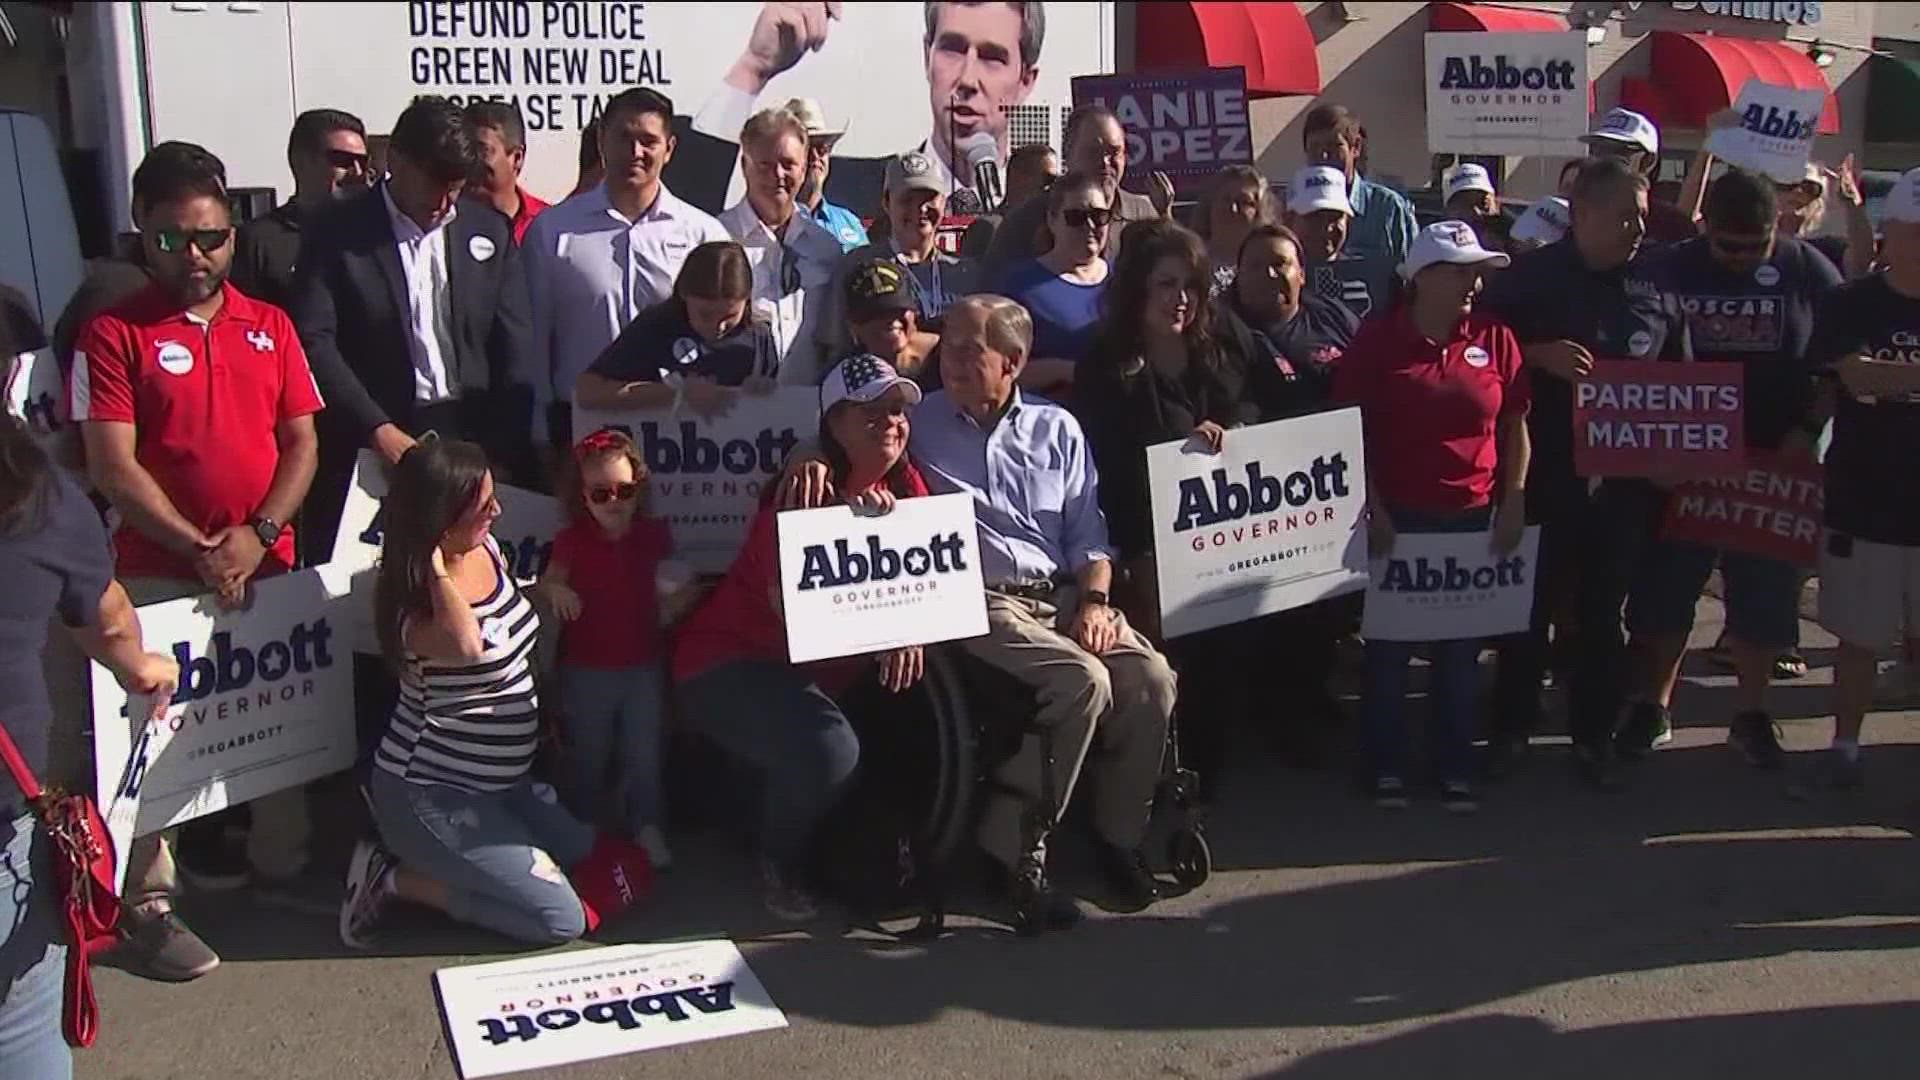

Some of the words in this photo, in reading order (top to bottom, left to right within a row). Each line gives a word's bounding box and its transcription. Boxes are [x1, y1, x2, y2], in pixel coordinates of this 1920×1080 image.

[409, 2, 531, 37] DEFUND
[542, 2, 645, 40] POLICE
[411, 47, 513, 85] GREEN
[524, 47, 589, 85] NEW
[600, 48, 672, 85] DEAL
[1440, 54, 1576, 90] Abbott
[1091, 89, 1247, 129] ANIE
[1451, 94, 1562, 105] GOVERNOR
[1125, 126, 1251, 167] OPEZ
[1577, 382, 1739, 411] PARENTS
[603, 421, 798, 475] bbott
[1587, 421, 1729, 450] MATTER
[660, 479, 759, 498] VERNO
[1172, 452, 1350, 533] Abbott
[1192, 507, 1336, 552] GOVERNOR
[797, 530, 968, 591] Abbott
[1378, 556, 1526, 594] Abbott
[833, 580, 937, 605] GOVERNOR
[169, 679, 315, 733] OVERNOR
[500, 973, 705, 1012] GOVERNOR
[478, 981, 737, 1046] Abbott
